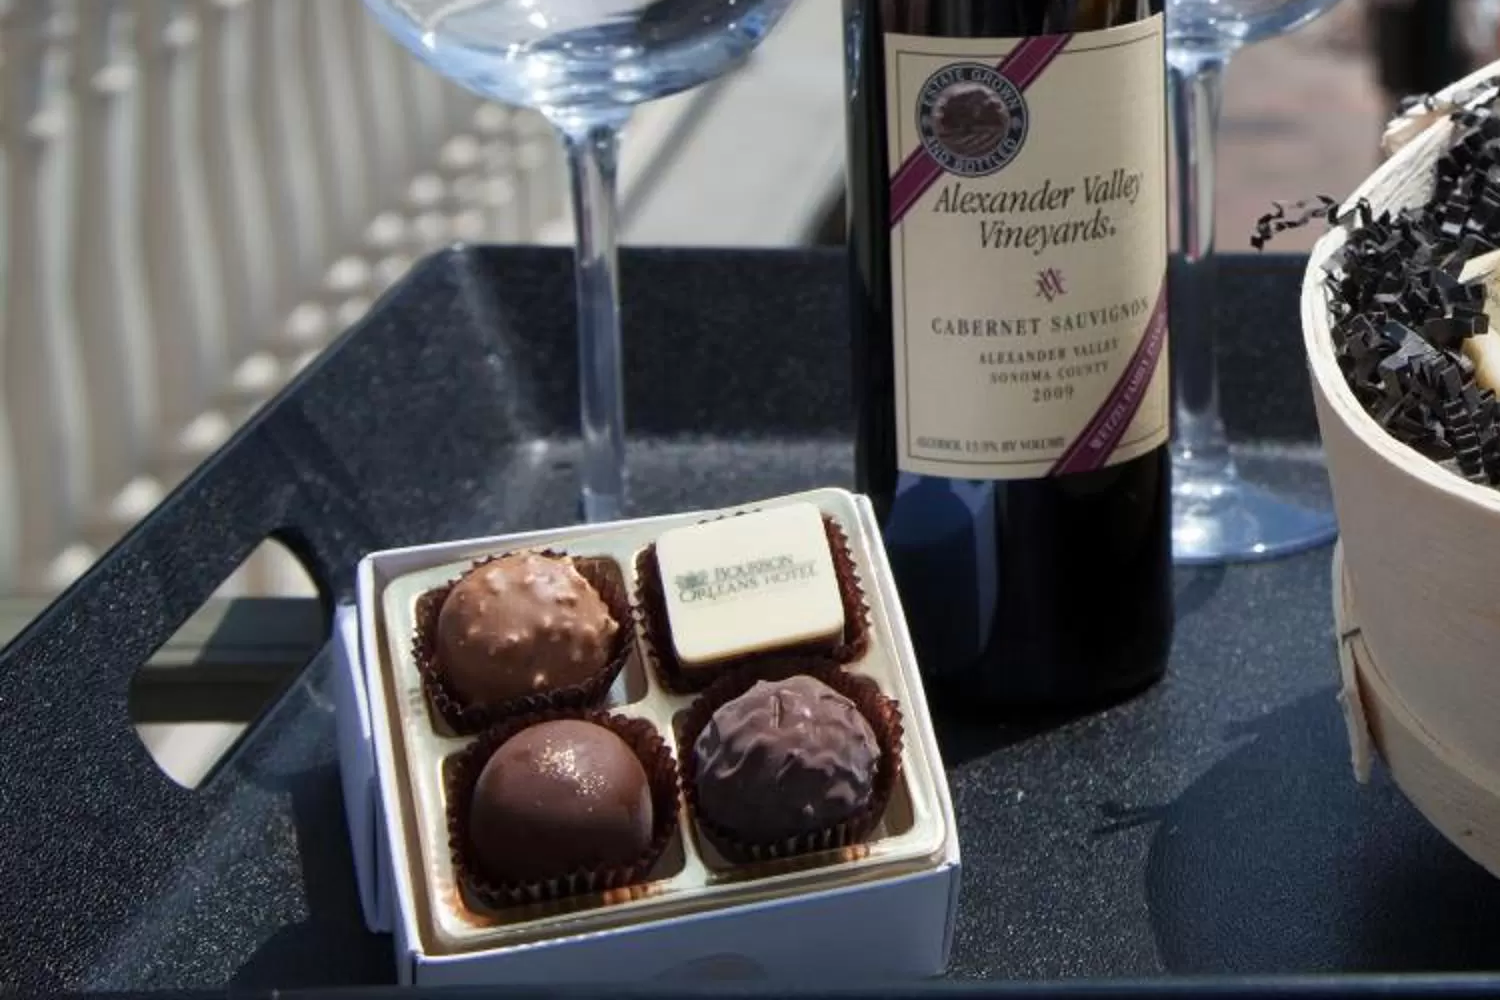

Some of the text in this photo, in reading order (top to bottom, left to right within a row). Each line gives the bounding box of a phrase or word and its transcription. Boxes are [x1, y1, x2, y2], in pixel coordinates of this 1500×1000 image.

[932, 167, 1144, 215] Alexander Valley
[931, 296, 1150, 338] CABERNET SAUVIGNON
[978, 337, 1121, 366] ALEXANDER VALLEY
[988, 359, 1110, 385] SONOMA COUNTY
[679, 560, 819, 603] ORLEANS HOTEL
[714, 553, 794, 582] BOURBON
